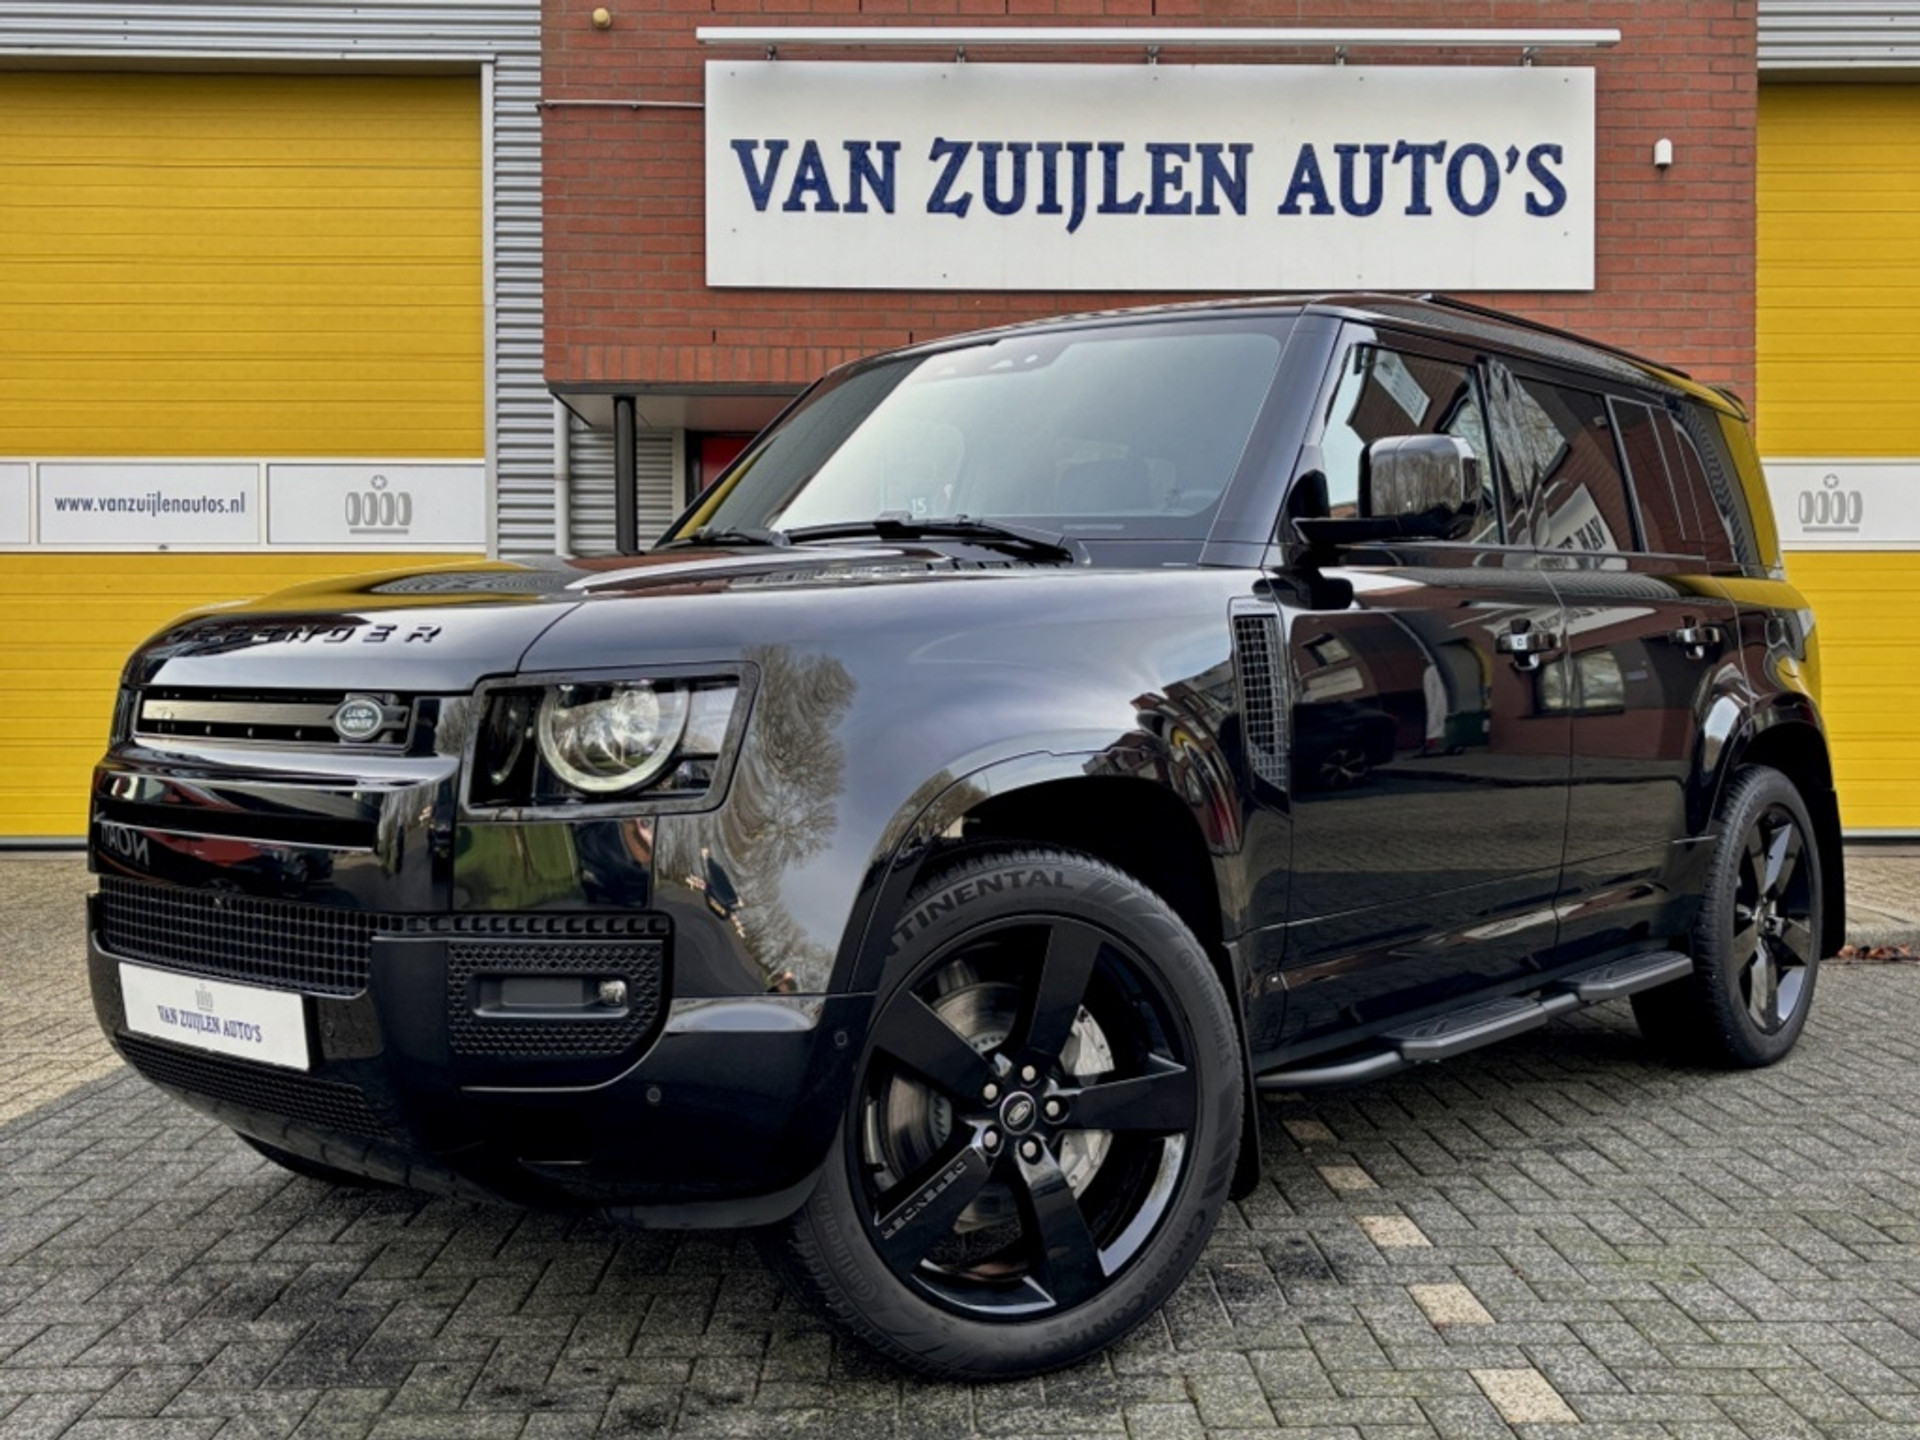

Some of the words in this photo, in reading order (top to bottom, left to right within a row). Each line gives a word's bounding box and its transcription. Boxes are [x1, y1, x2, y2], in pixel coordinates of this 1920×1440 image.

[730, 139, 901, 215] VAN
[926, 136, 1254, 235] ZUIJLEN
[1278, 139, 1568, 218] AUTO'S
[54, 490, 246, 519] www.vanzuijlenautos.nl
[157, 1004, 178, 1024] VAN
[179, 1010, 221, 1035] ZUIJLEN
[223, 1019, 264, 1044] AUTO'S
